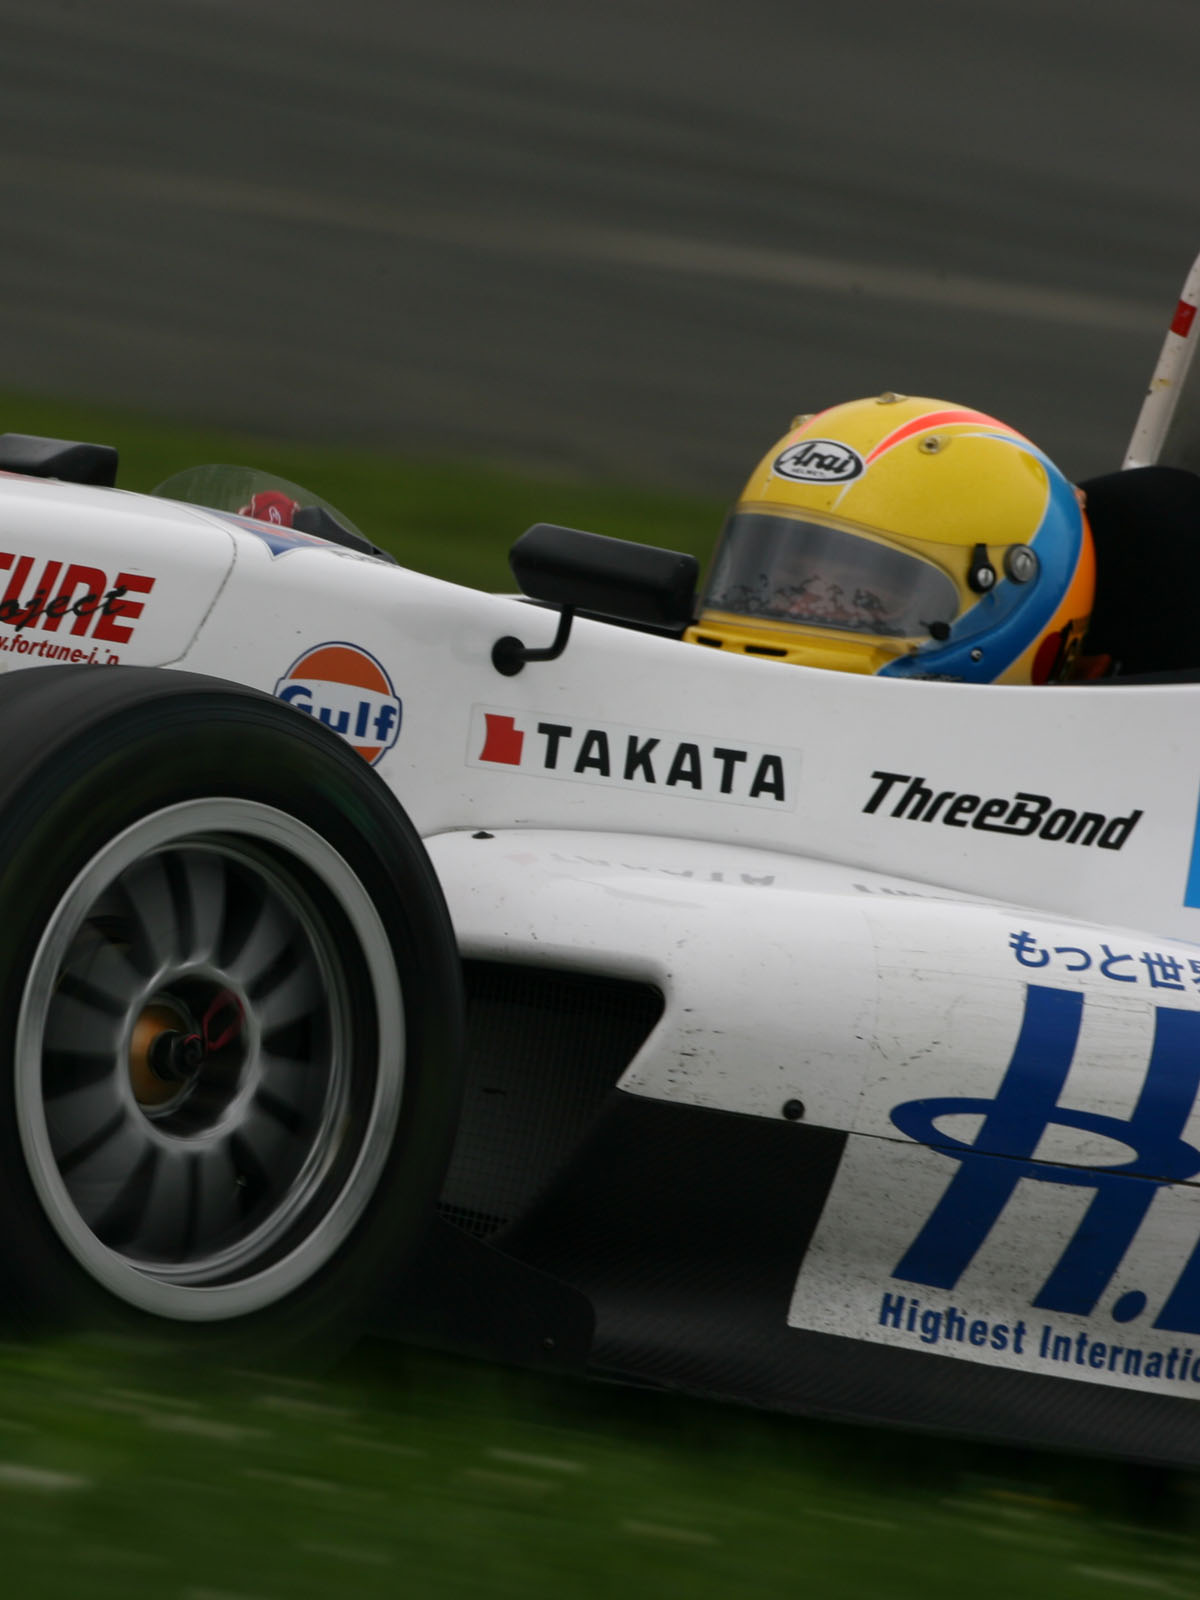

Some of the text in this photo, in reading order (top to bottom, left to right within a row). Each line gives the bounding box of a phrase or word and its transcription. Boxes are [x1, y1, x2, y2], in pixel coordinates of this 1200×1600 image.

[780, 443, 852, 474] Arai
[537, 722, 786, 801] TAKATA
[862, 770, 1144, 851] ThreeBond
[1008, 930, 1200, 992] もっと世
[878, 1292, 1026, 1354] Highest
